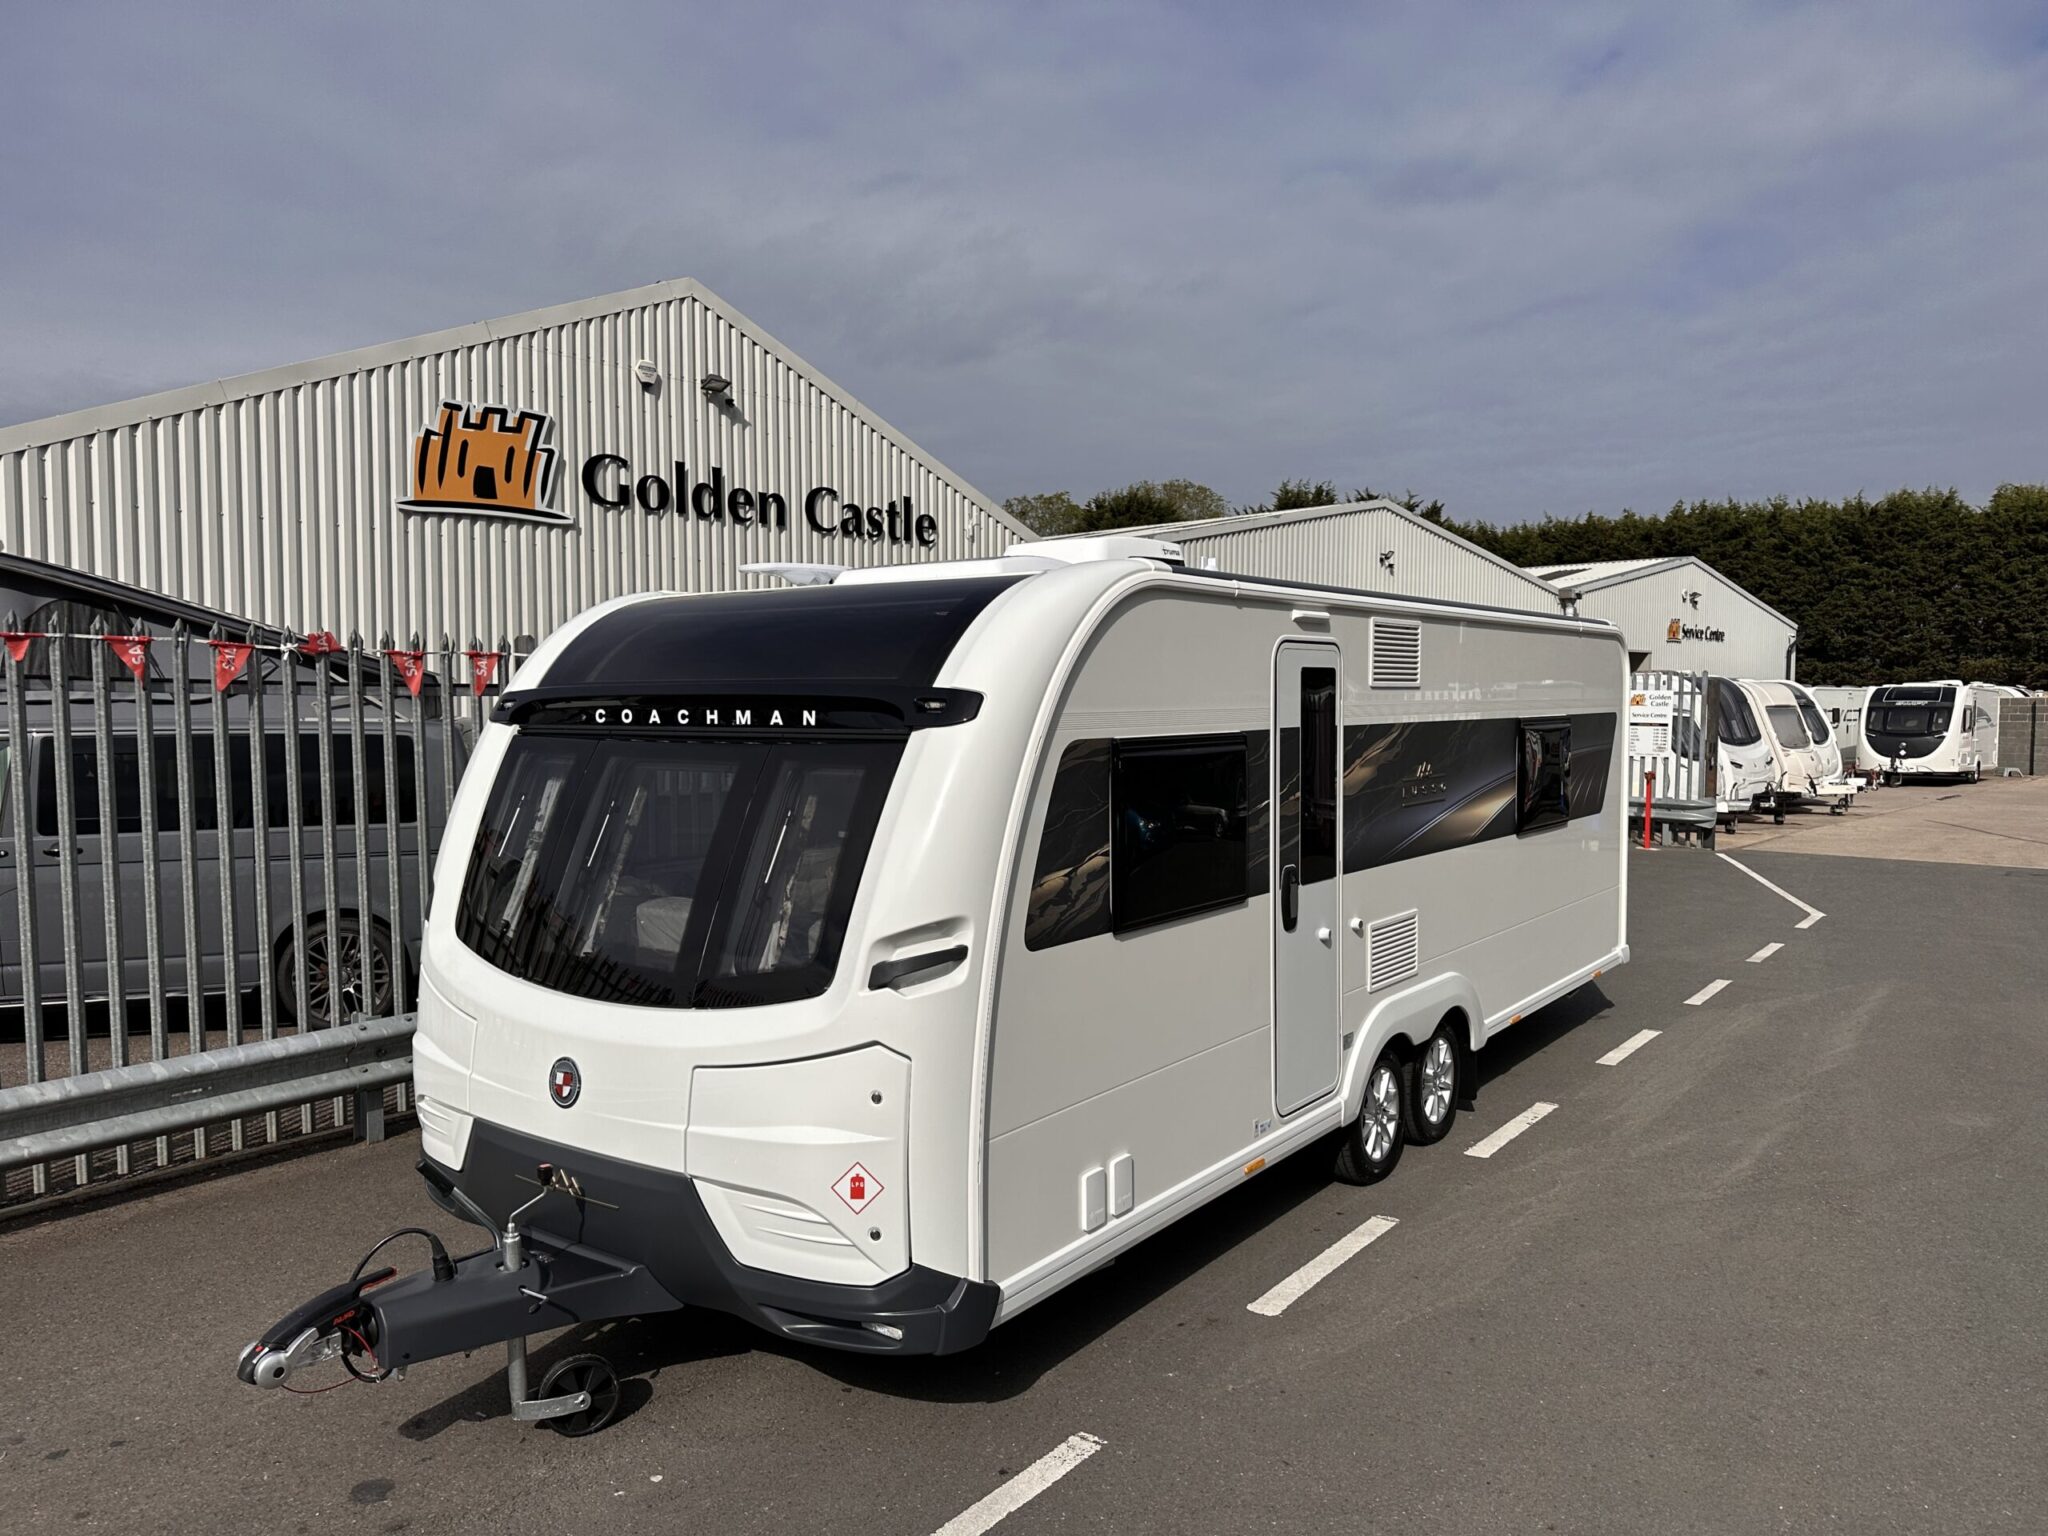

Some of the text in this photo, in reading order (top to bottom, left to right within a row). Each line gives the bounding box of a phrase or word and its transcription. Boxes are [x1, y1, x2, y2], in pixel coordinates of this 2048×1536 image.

[582, 453, 938, 545] Golden Castle
[1682, 623, 1725, 642] Service Centre
[595, 708, 816, 726] COACHMAN
